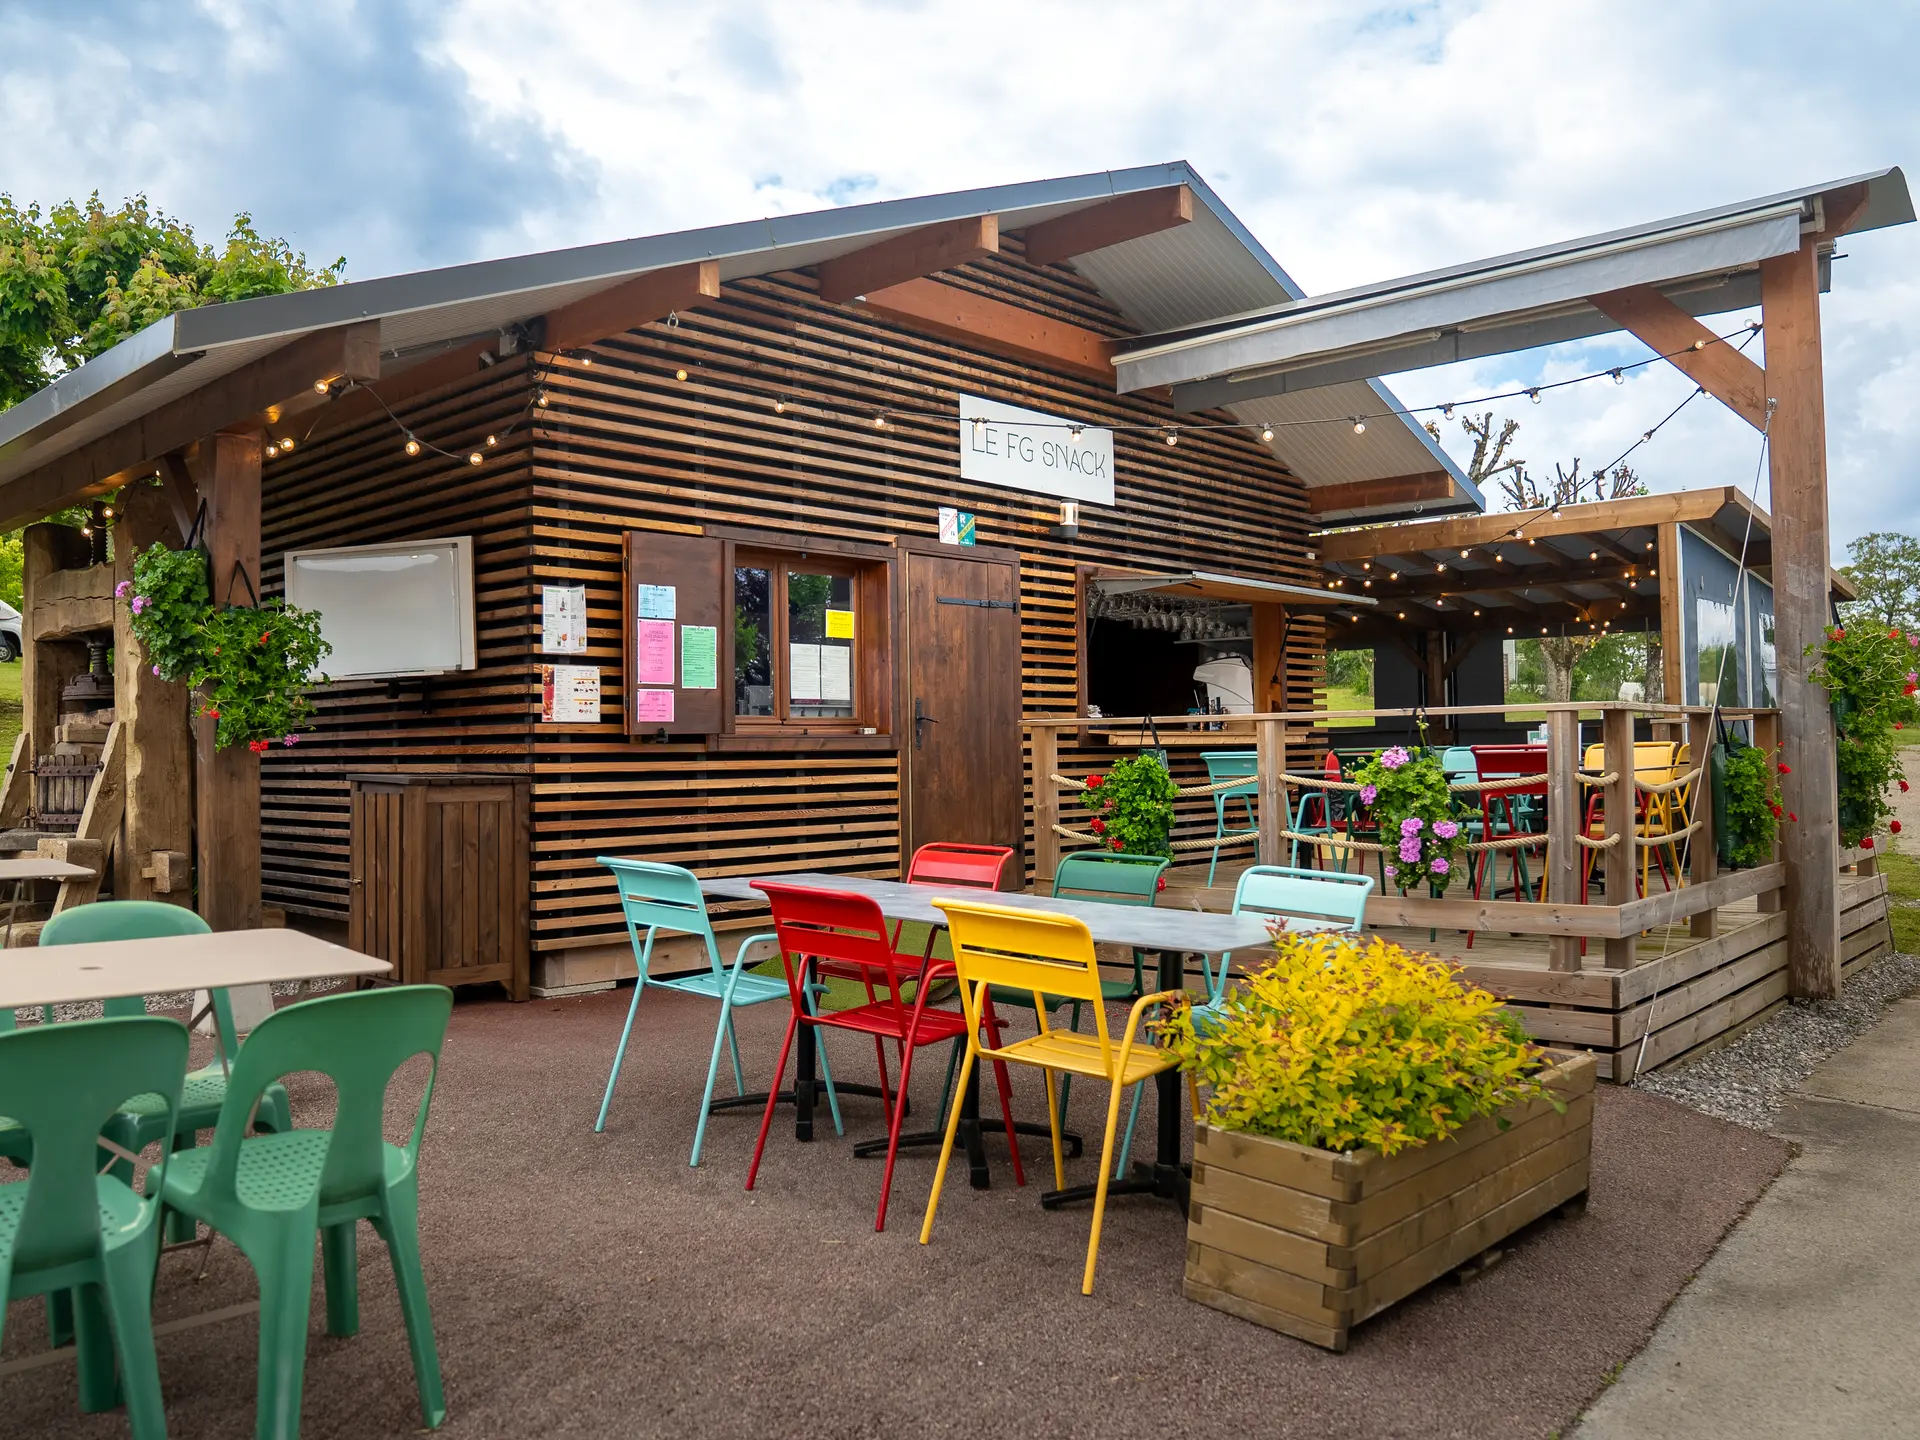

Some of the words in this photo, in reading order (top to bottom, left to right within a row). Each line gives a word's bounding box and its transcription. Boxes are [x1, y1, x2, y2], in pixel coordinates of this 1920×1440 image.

[972, 424, 998, 456] LE
[1007, 432, 1034, 462] FG
[1042, 441, 1106, 478] SNACK
